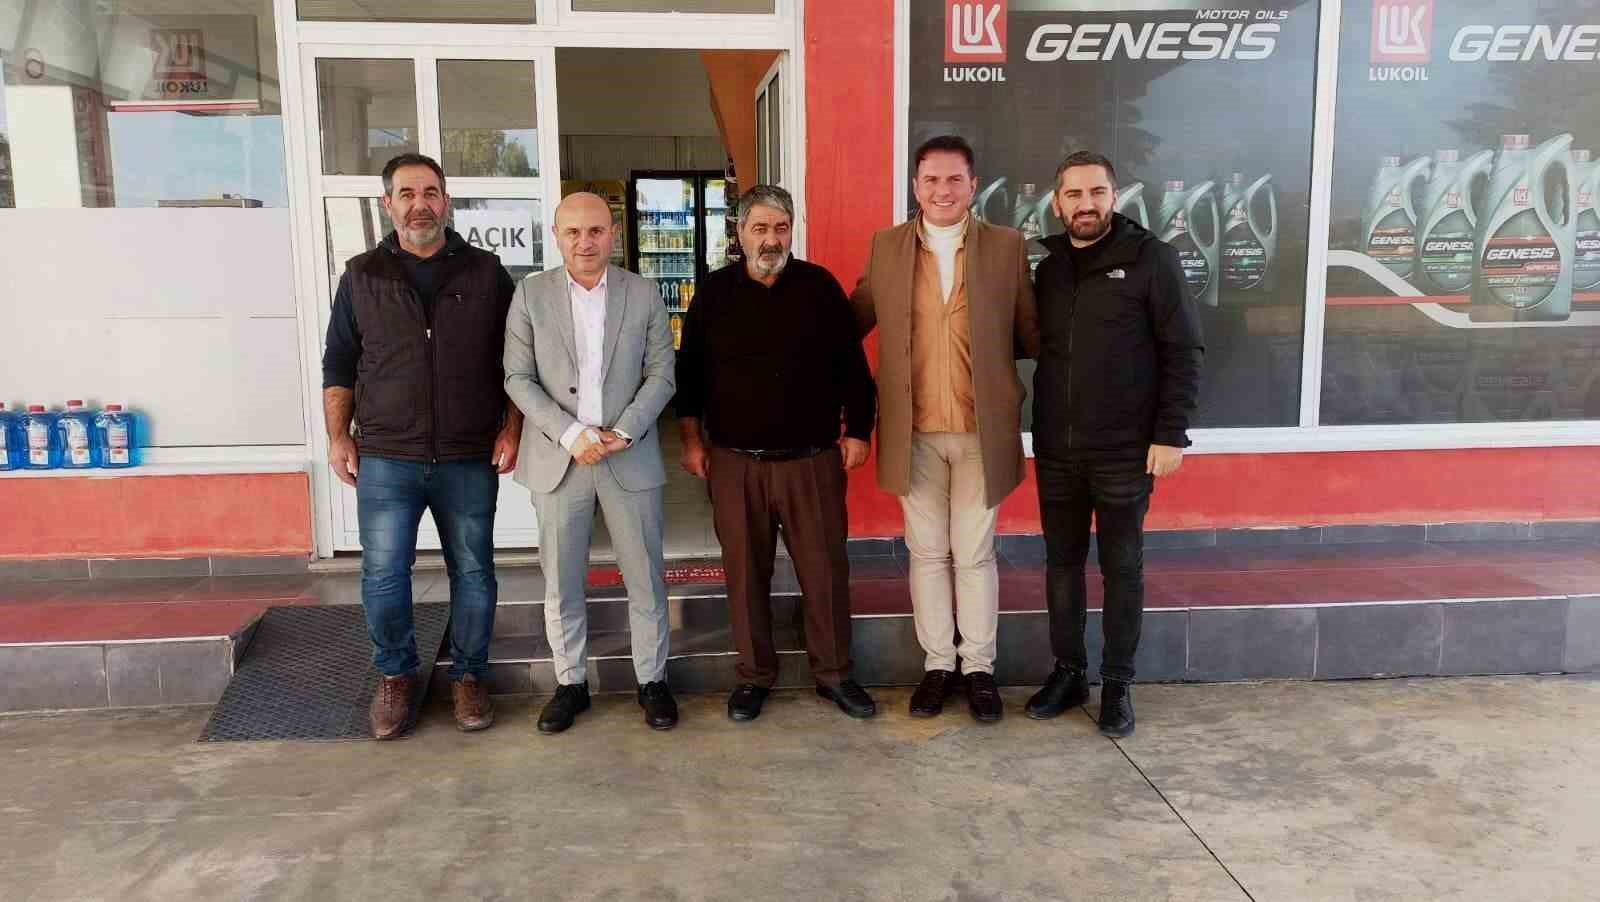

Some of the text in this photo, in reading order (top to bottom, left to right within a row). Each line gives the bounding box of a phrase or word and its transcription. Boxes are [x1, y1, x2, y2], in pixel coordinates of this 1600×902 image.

[1196, 9, 1289, 20] MOTOR OILS
[1025, 22, 1281, 62] GENESIS
[1448, 24, 1600, 62] GENE
[943, 66, 1006, 82] LUKOIL
[1368, 66, 1429, 82] LUKOIL
[467, 226, 526, 253] AÇIK
[1486, 247, 1557, 260] GENESIS
